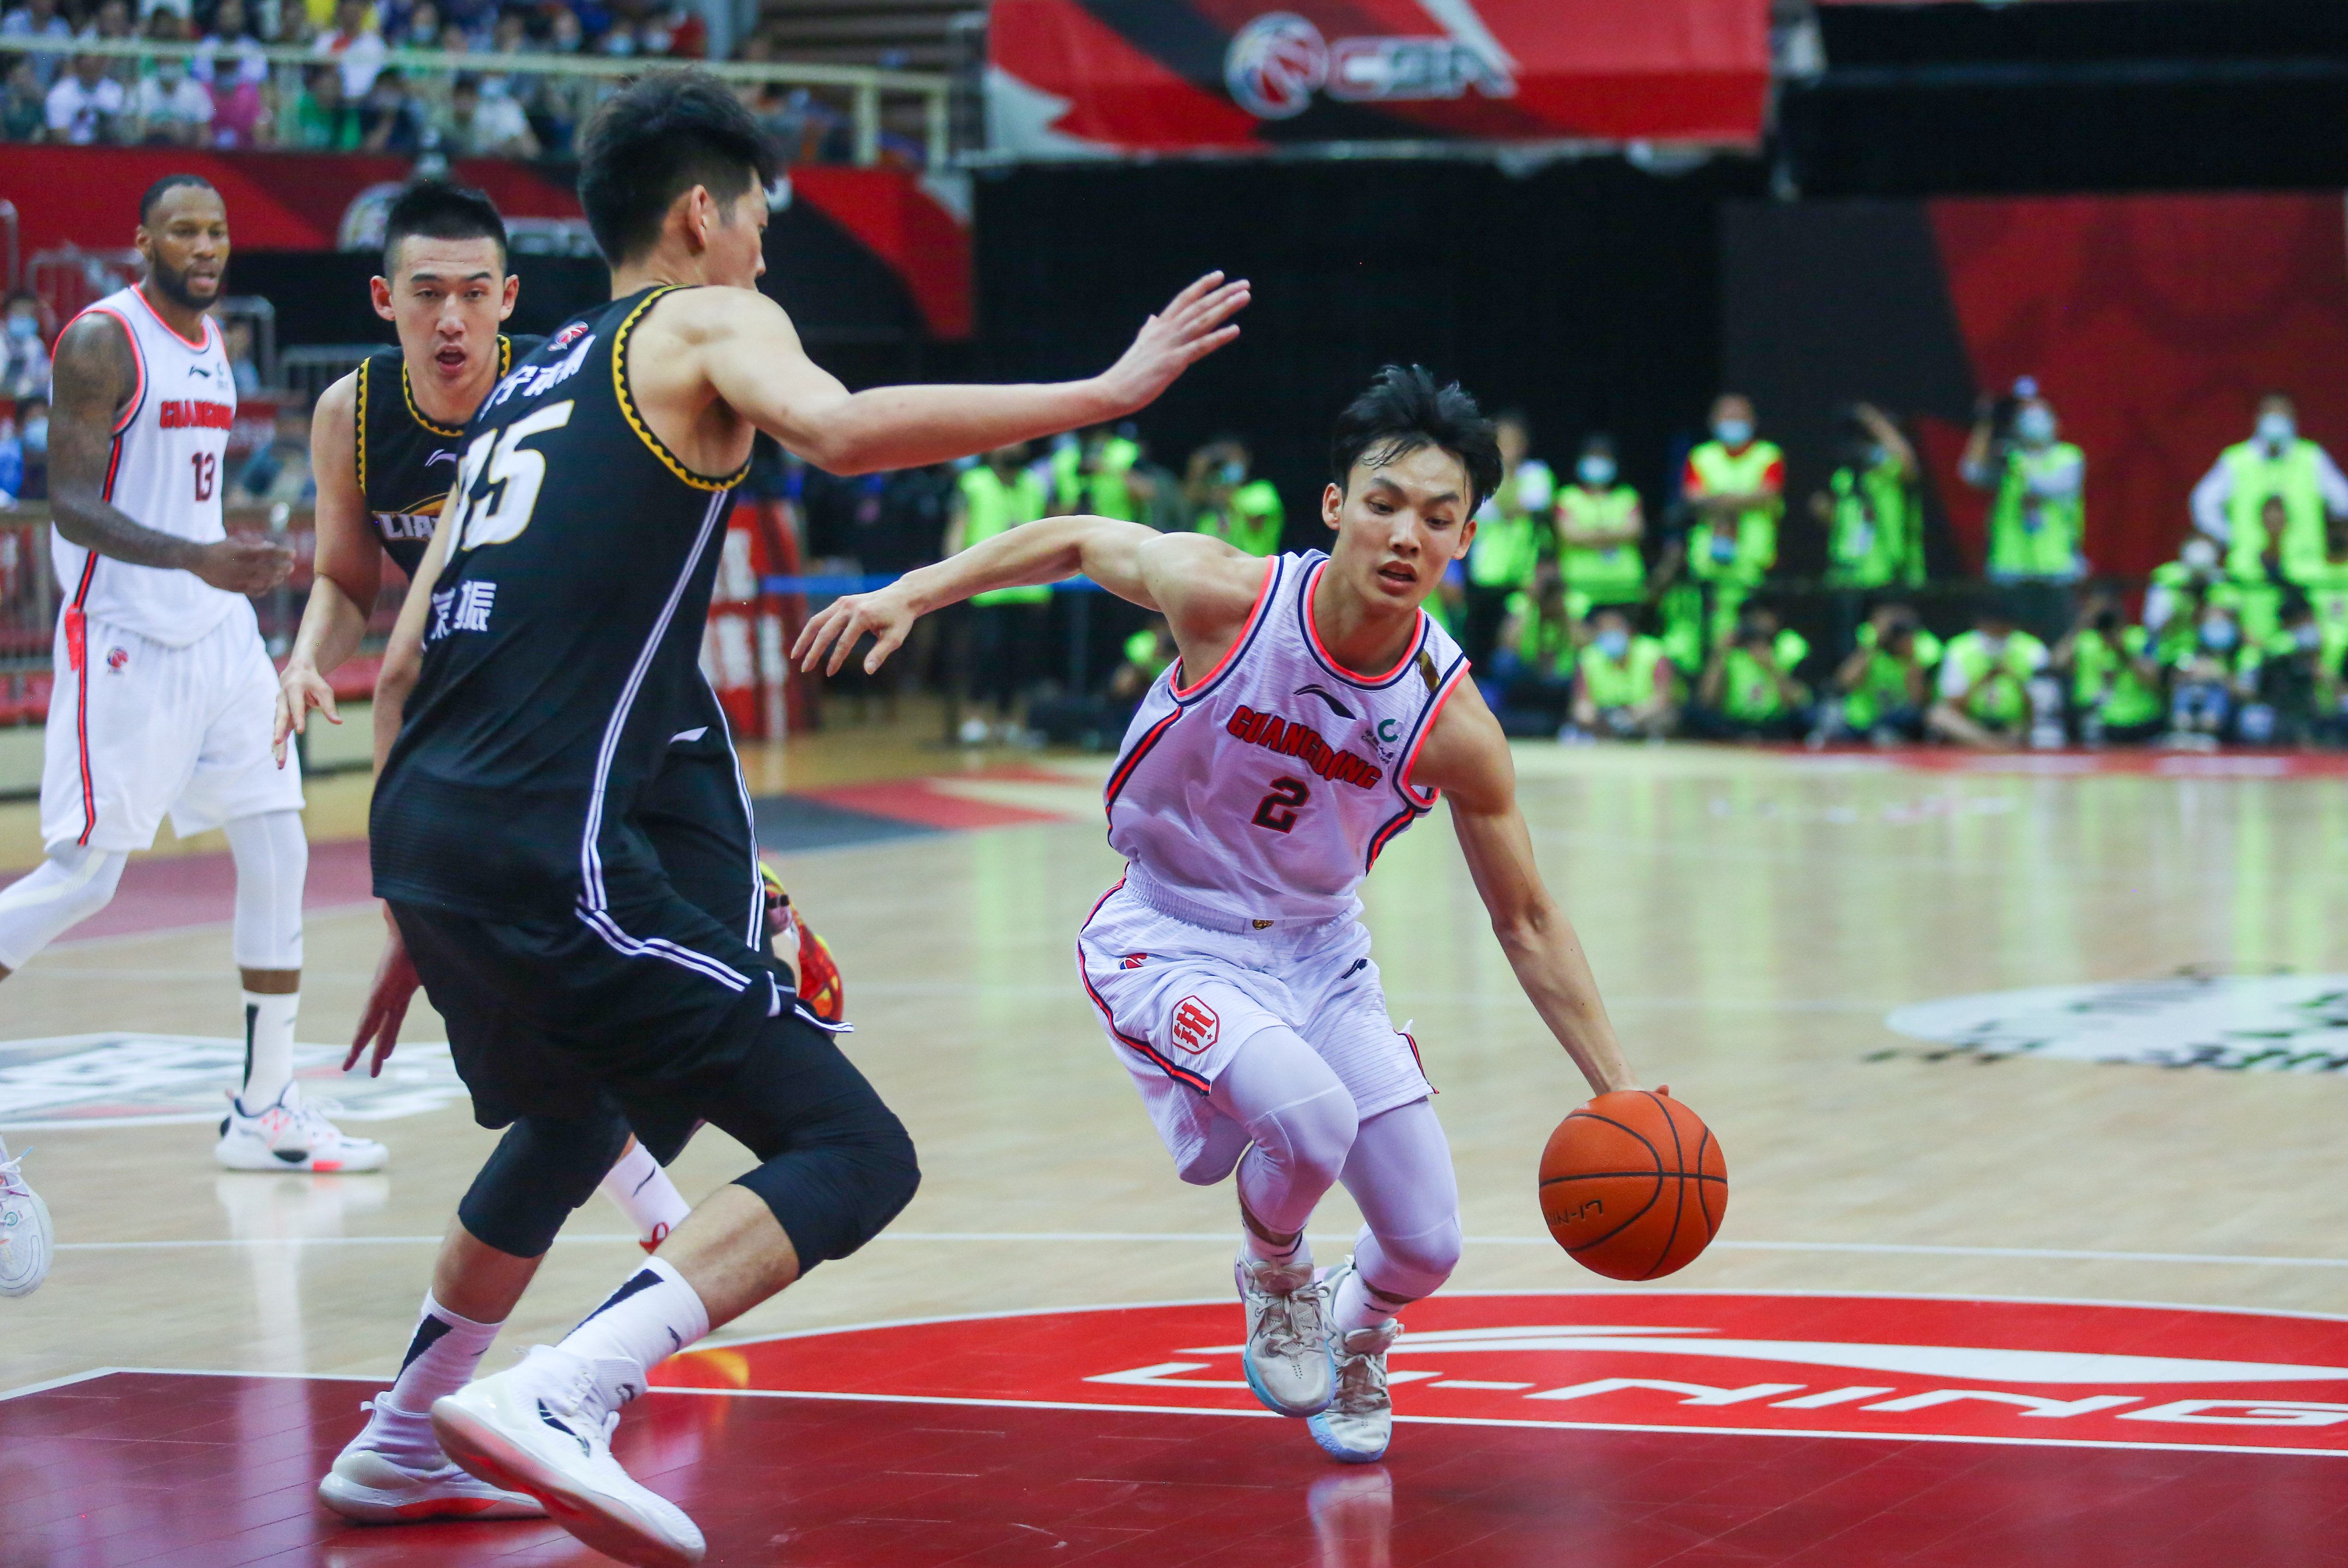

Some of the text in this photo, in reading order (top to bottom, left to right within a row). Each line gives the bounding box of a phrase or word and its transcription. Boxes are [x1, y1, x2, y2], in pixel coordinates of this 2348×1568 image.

[192, 452, 216, 502] 13
[378, 513, 439, 538] LIA
[1226, 704, 1384, 790] GUANGDONG
[1251, 776, 1311, 834] 2
